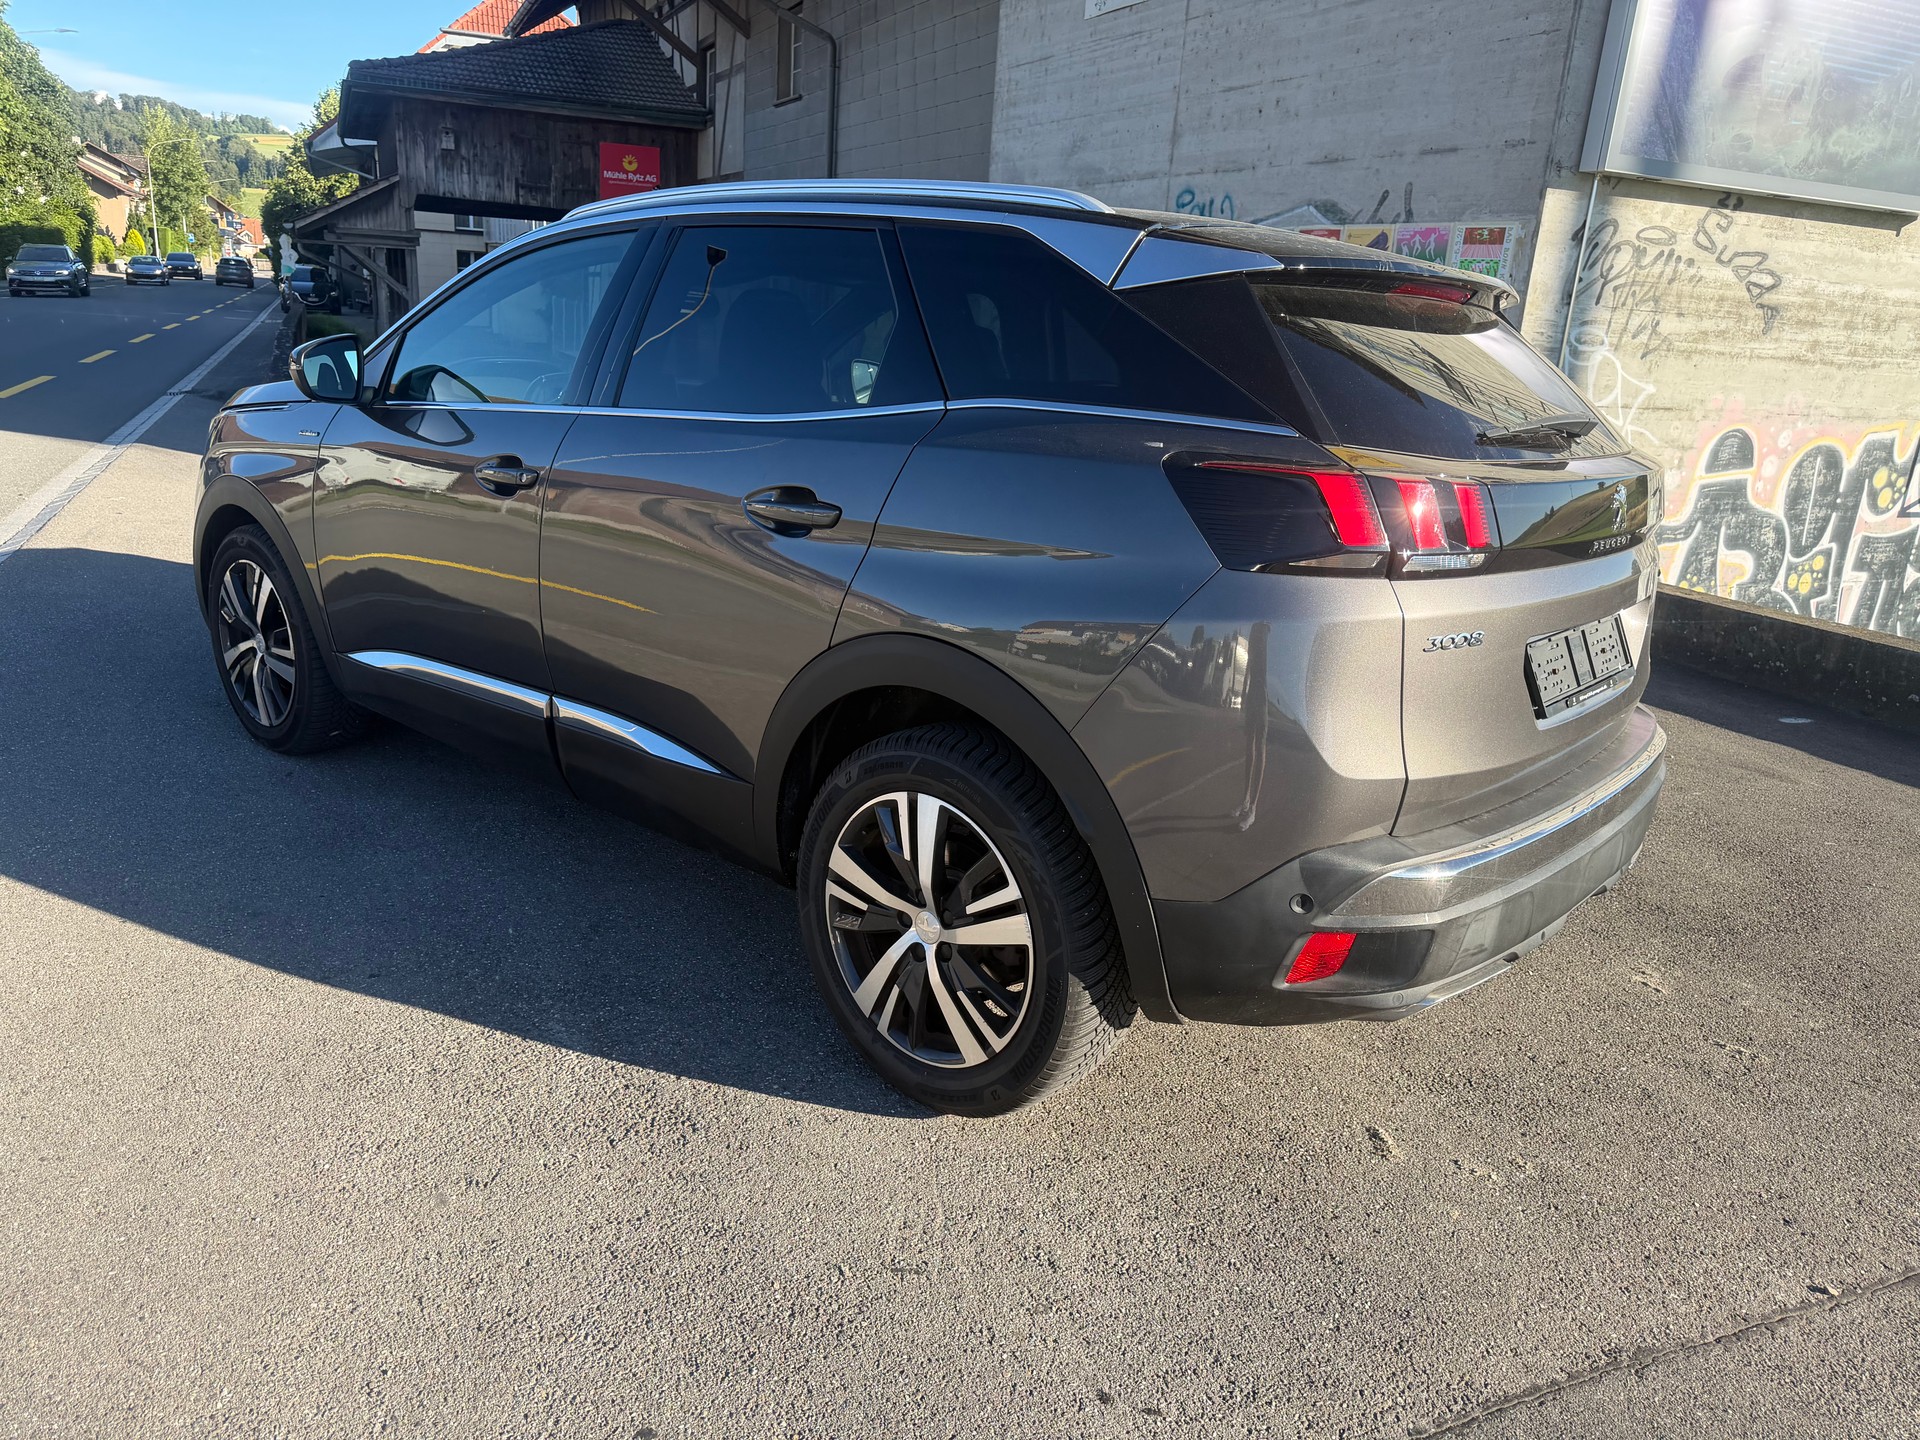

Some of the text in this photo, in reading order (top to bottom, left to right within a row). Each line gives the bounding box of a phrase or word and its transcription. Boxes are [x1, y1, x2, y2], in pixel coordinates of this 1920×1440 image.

[603, 170, 657, 183] Mühle Rytz AG
[1505, 226, 1514, 244] BAD
[1500, 247, 1511, 270] BONN
[1593, 535, 1631, 551] PEUGEOT
[1422, 630, 1485, 652] 3008
